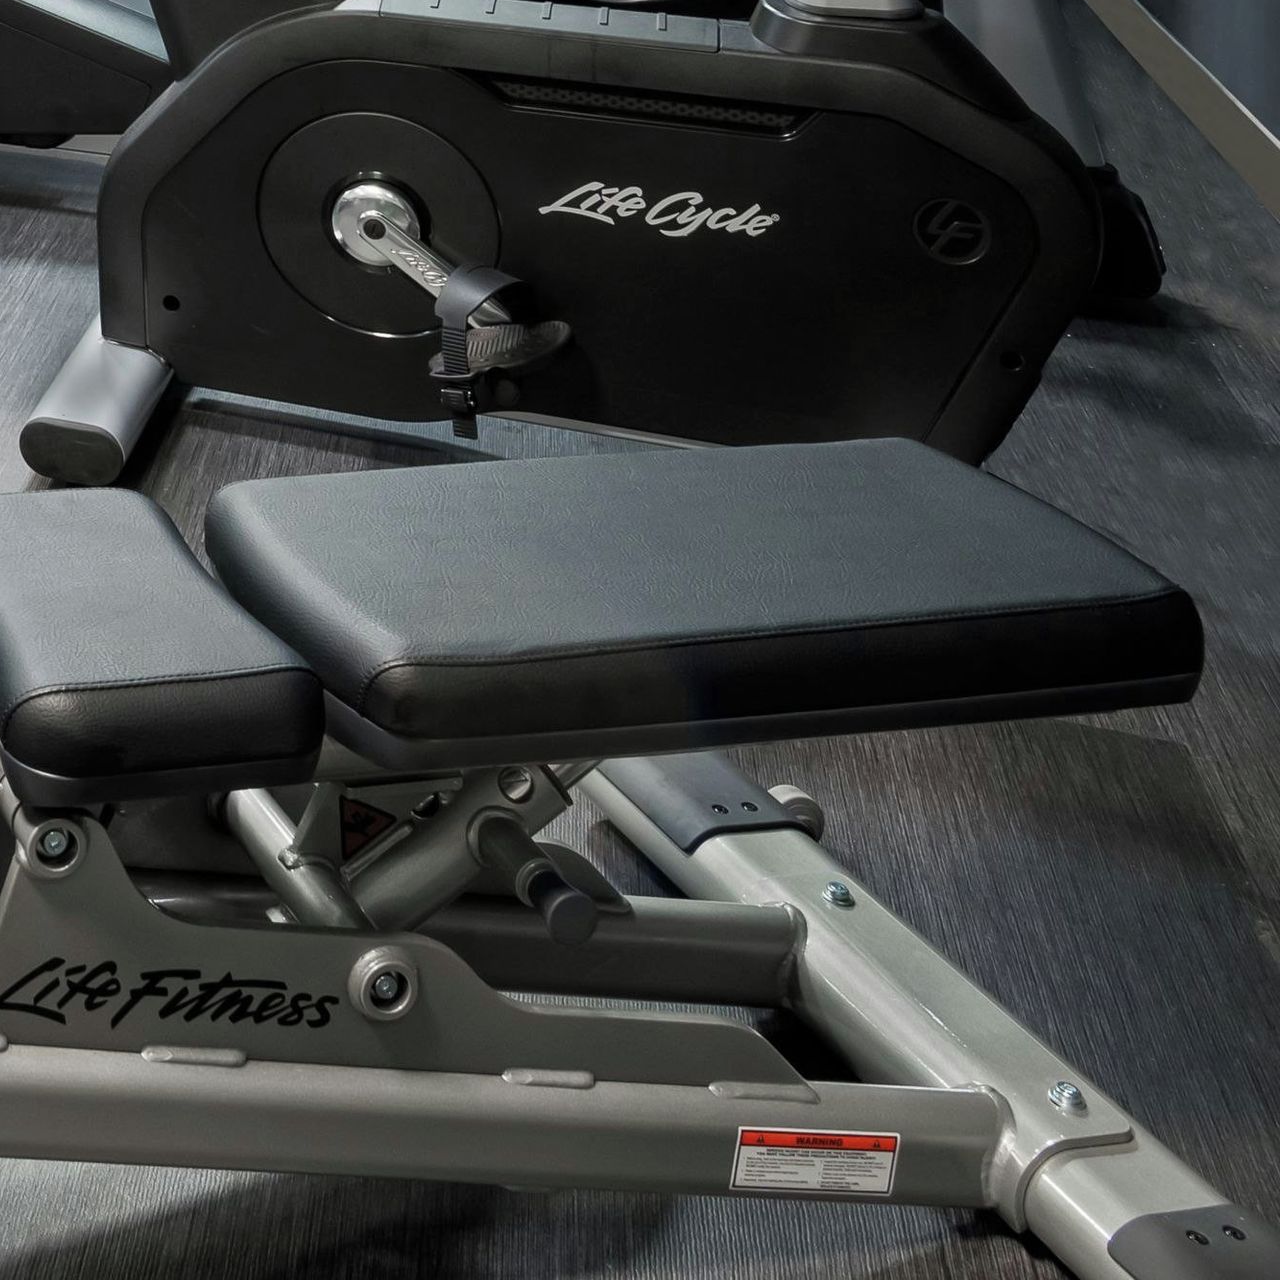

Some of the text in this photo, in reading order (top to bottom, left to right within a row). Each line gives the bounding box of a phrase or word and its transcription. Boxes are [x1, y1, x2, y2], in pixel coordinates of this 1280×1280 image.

[538, 181, 775, 237] Life Cycle
[110, 969, 340, 1030] Fitness
[796, 1136, 844, 1147] WARNING
